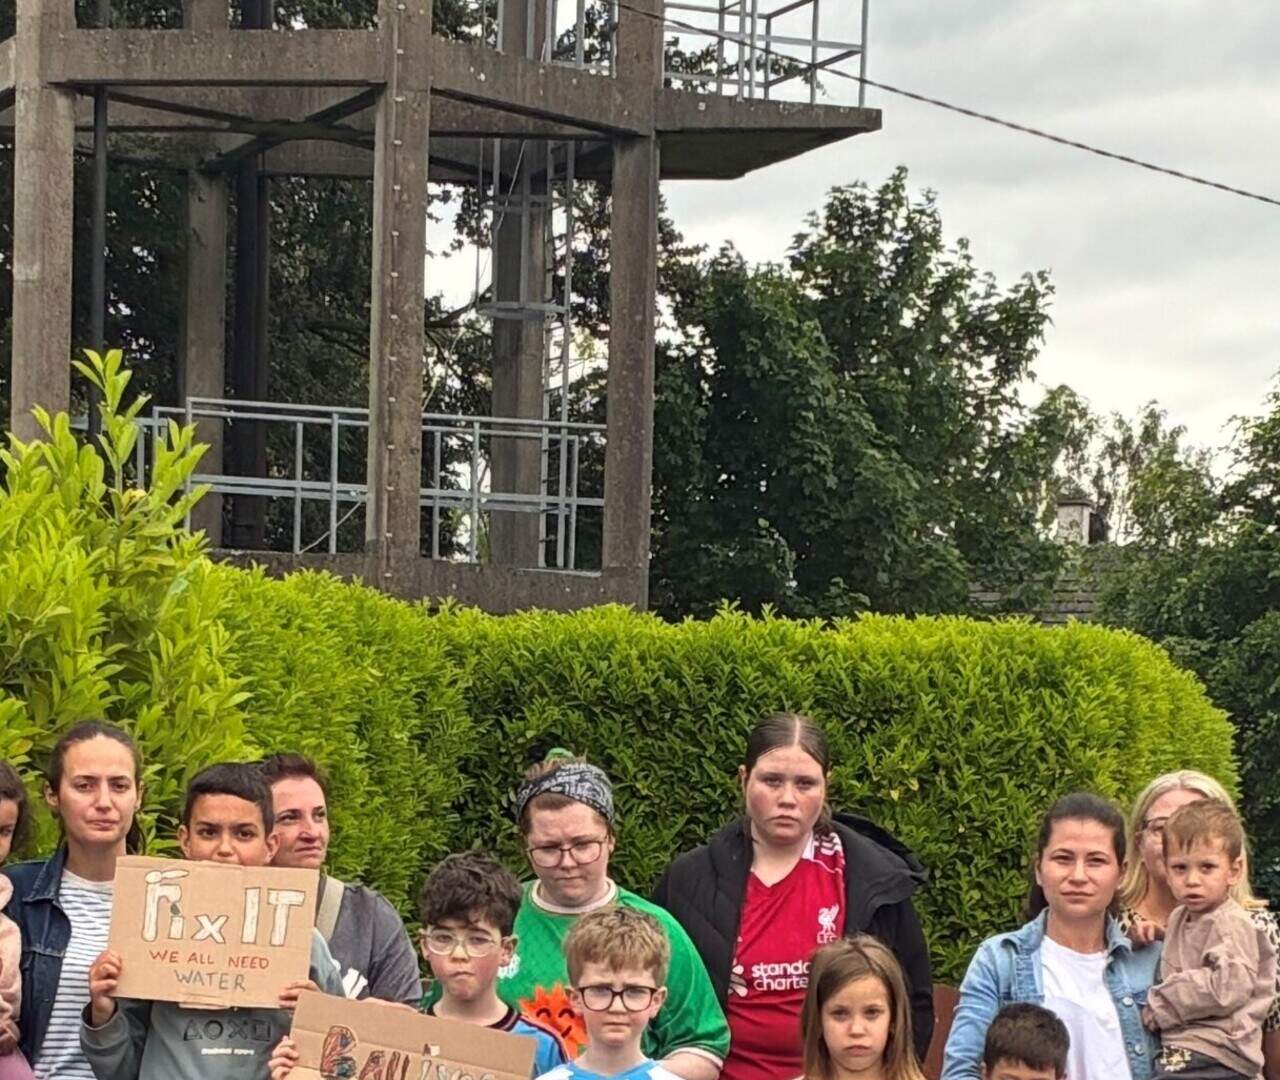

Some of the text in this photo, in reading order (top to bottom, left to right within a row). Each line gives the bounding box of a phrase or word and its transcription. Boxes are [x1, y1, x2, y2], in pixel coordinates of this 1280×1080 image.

[241, 886, 307, 947] IT
[149, 950, 270, 970] WE ALL NEED
[174, 969, 246, 992] WATER
[753, 975, 808, 992] charte
